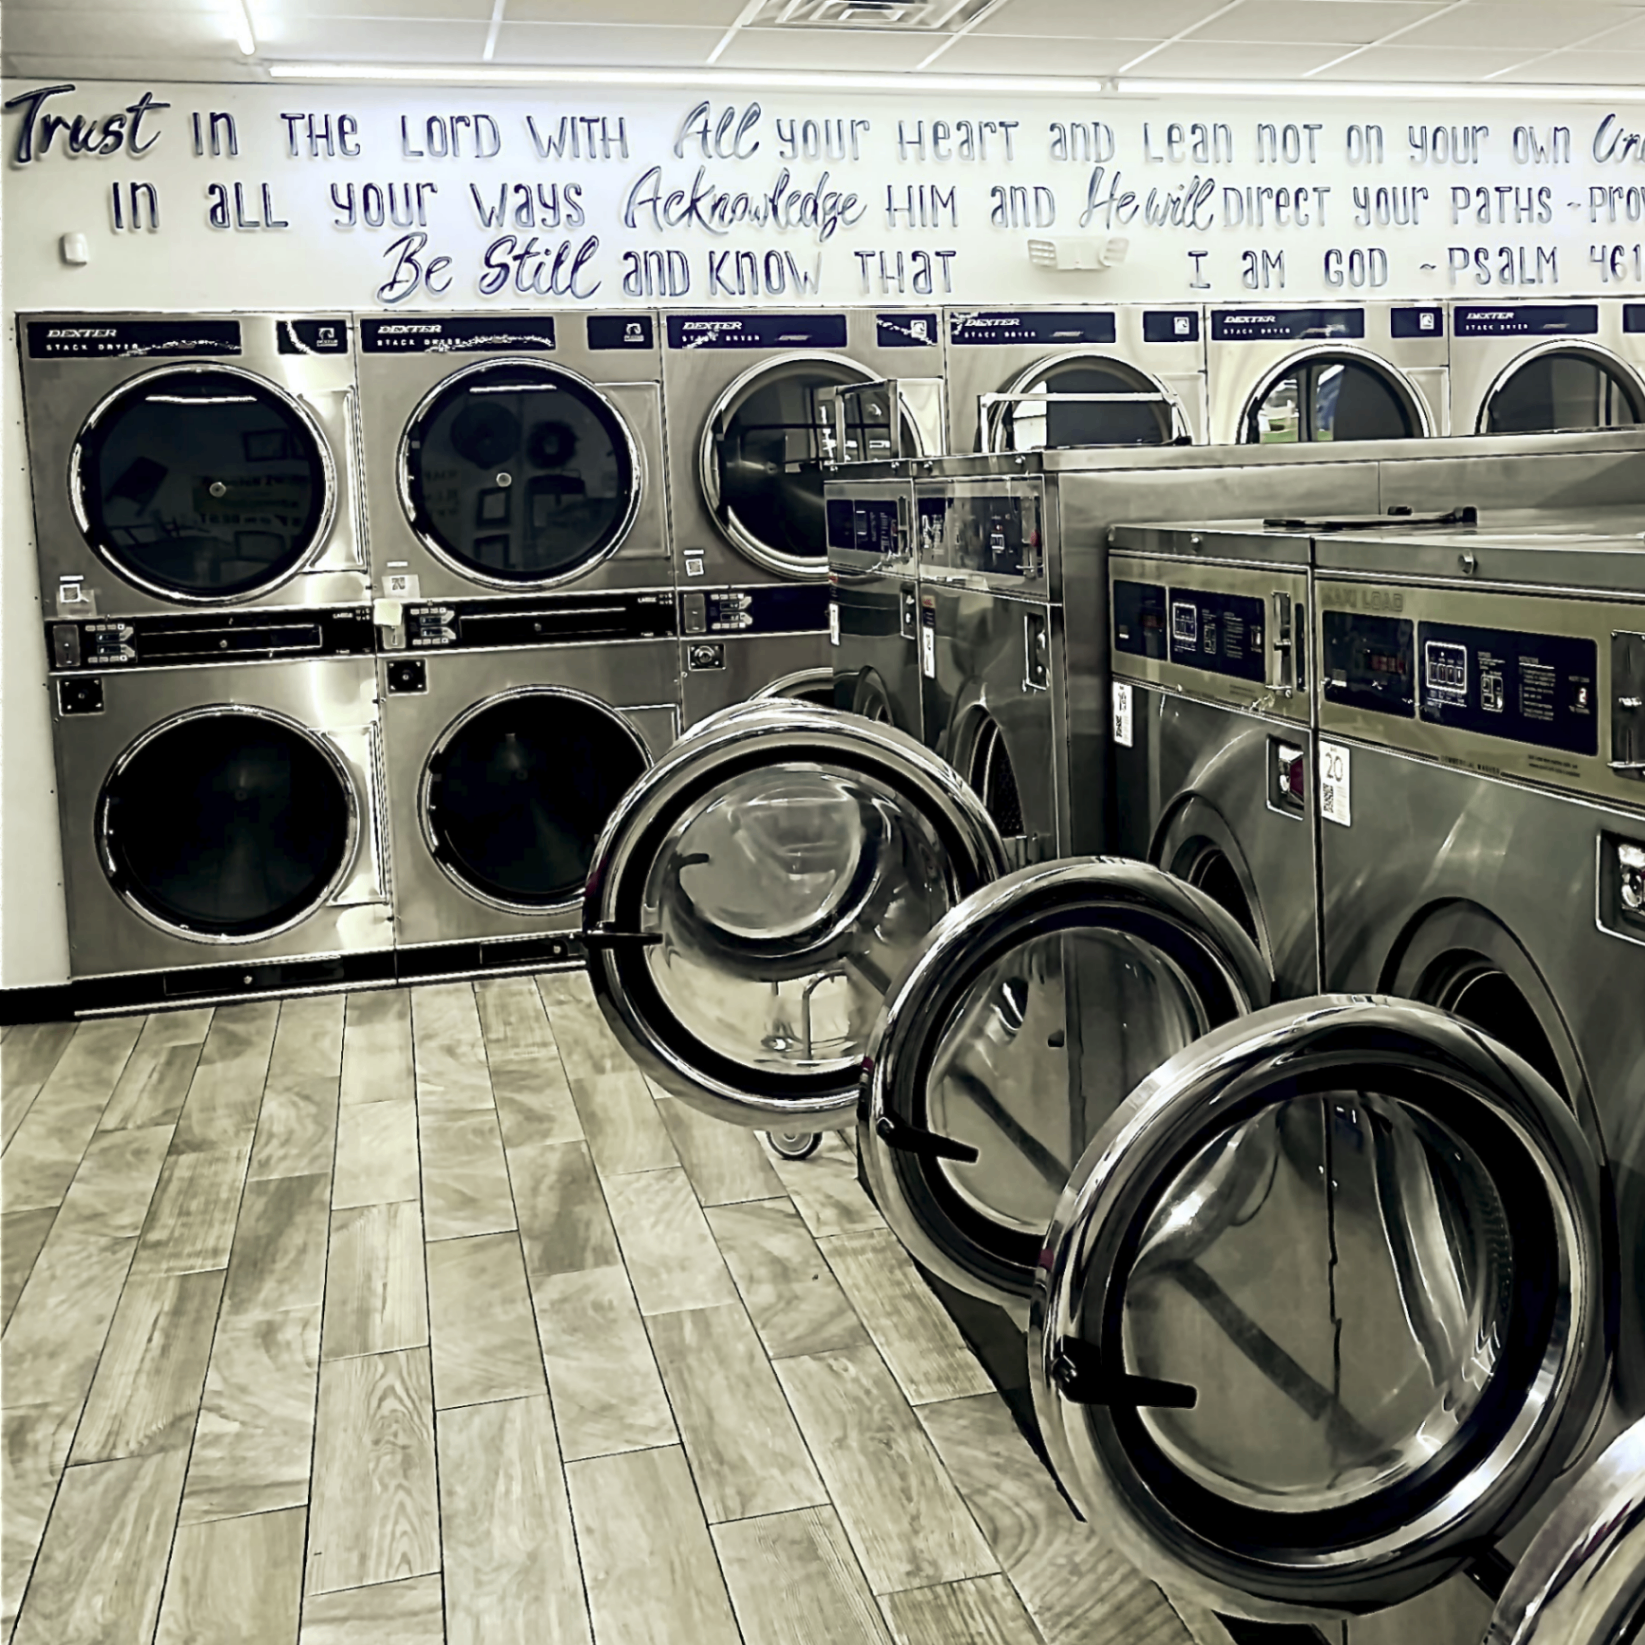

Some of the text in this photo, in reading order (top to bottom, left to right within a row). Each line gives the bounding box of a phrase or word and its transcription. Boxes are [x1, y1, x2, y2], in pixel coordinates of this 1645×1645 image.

[3, 84, 171, 163] Trust
[526, 115, 629, 159] WITH
[673, 100, 761, 160] All
[624, 165, 867, 243] Acknowledge
[885, 184, 958, 228] HIM
[1079, 166, 1139, 230] He
[1145, 175, 1215, 231] will
[377, 232, 453, 304] Be
[478, 234, 602, 300] Still
[1188, 250, 1211, 289] I
[1324, 248, 1388, 287] GOD
[377, 324, 442, 334] DEXTER
[682, 321, 743, 330] DEXTER
[964, 318, 1021, 327] DEXTER
[1223, 315, 1276, 323] DEXTER
[46, 328, 117, 338] DEXTER
[1325, 751, 1344, 782] 20
